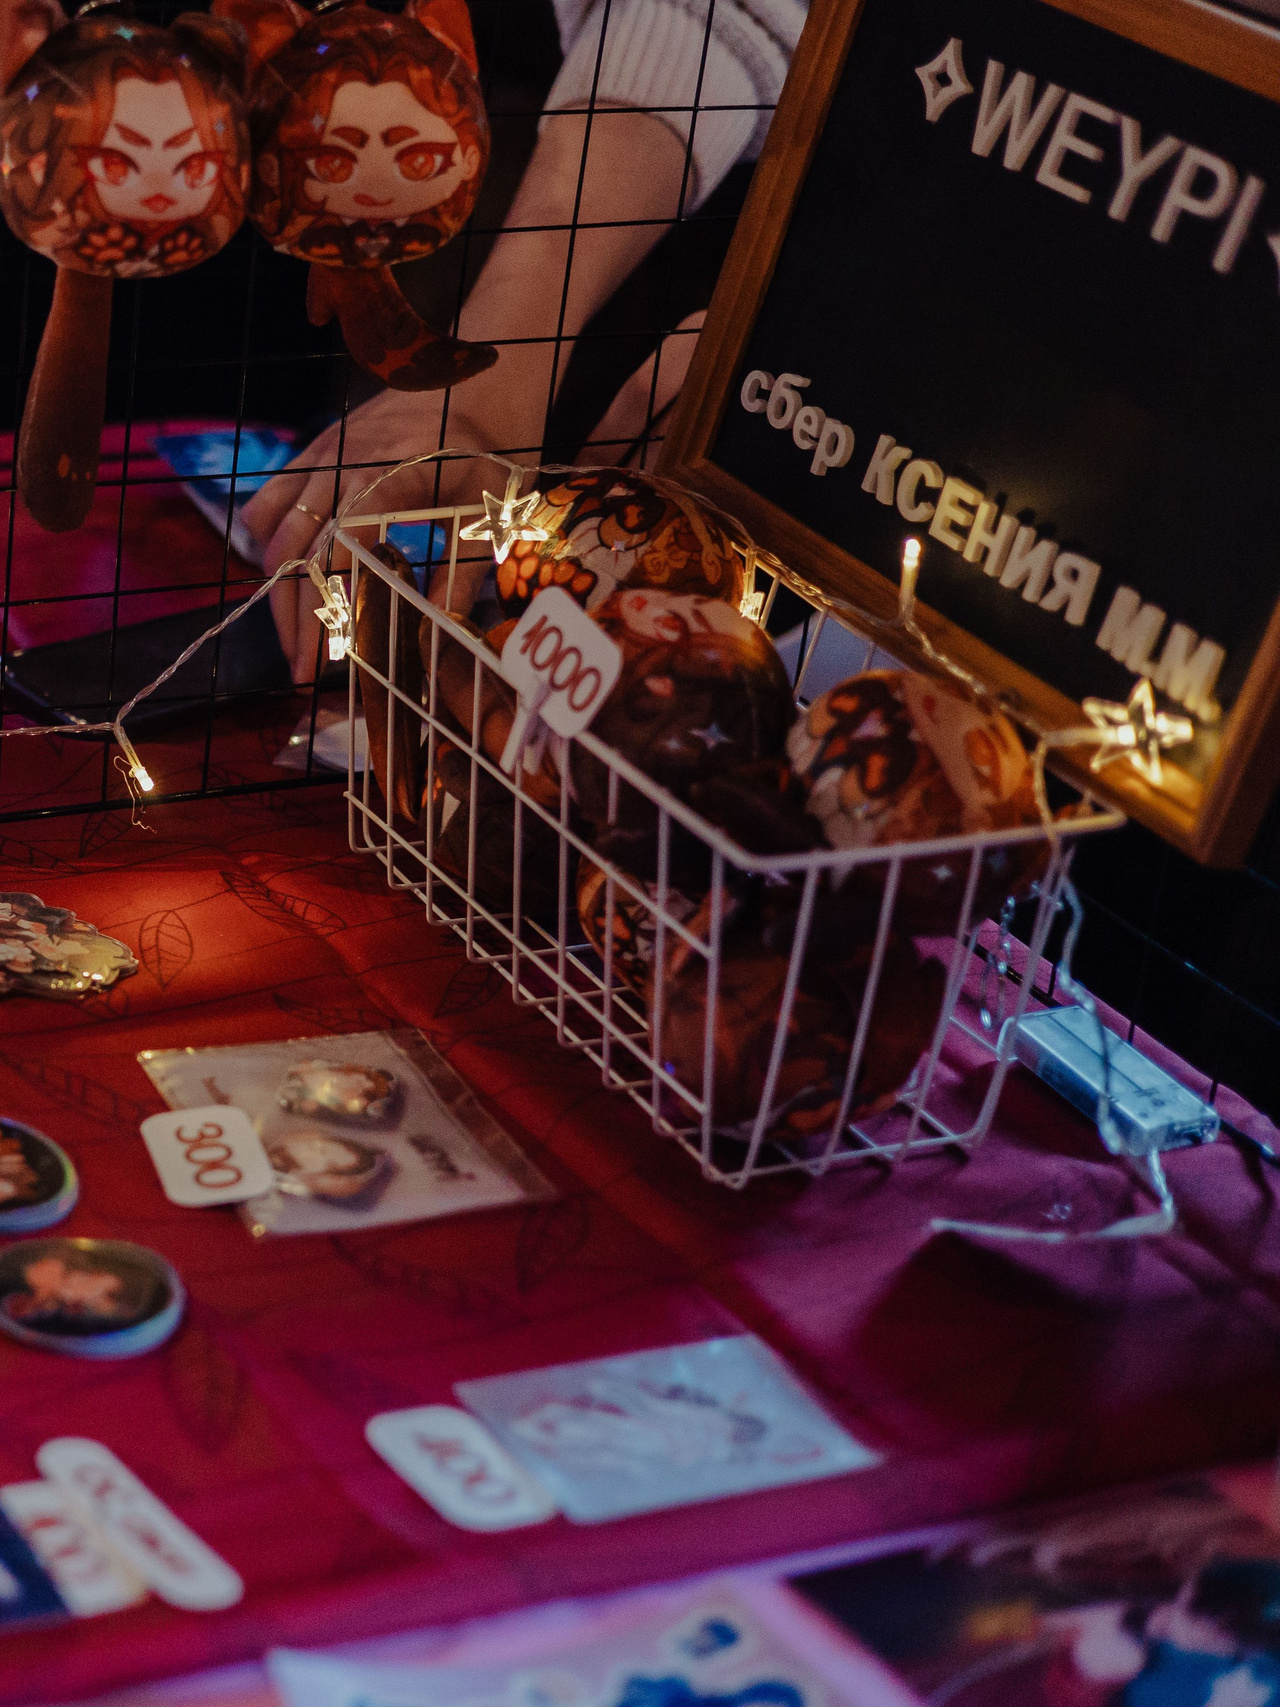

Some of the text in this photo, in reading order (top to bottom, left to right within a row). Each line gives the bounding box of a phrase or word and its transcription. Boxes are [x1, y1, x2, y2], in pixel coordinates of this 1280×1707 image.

[971, 59, 1266, 276] WEYPI
[740, 369, 856, 477] сбер
[860, 433, 1102, 628] КСЕНИЯ
[519, 614, 602, 713] 1000
[175, 1121, 243, 1190] 300
